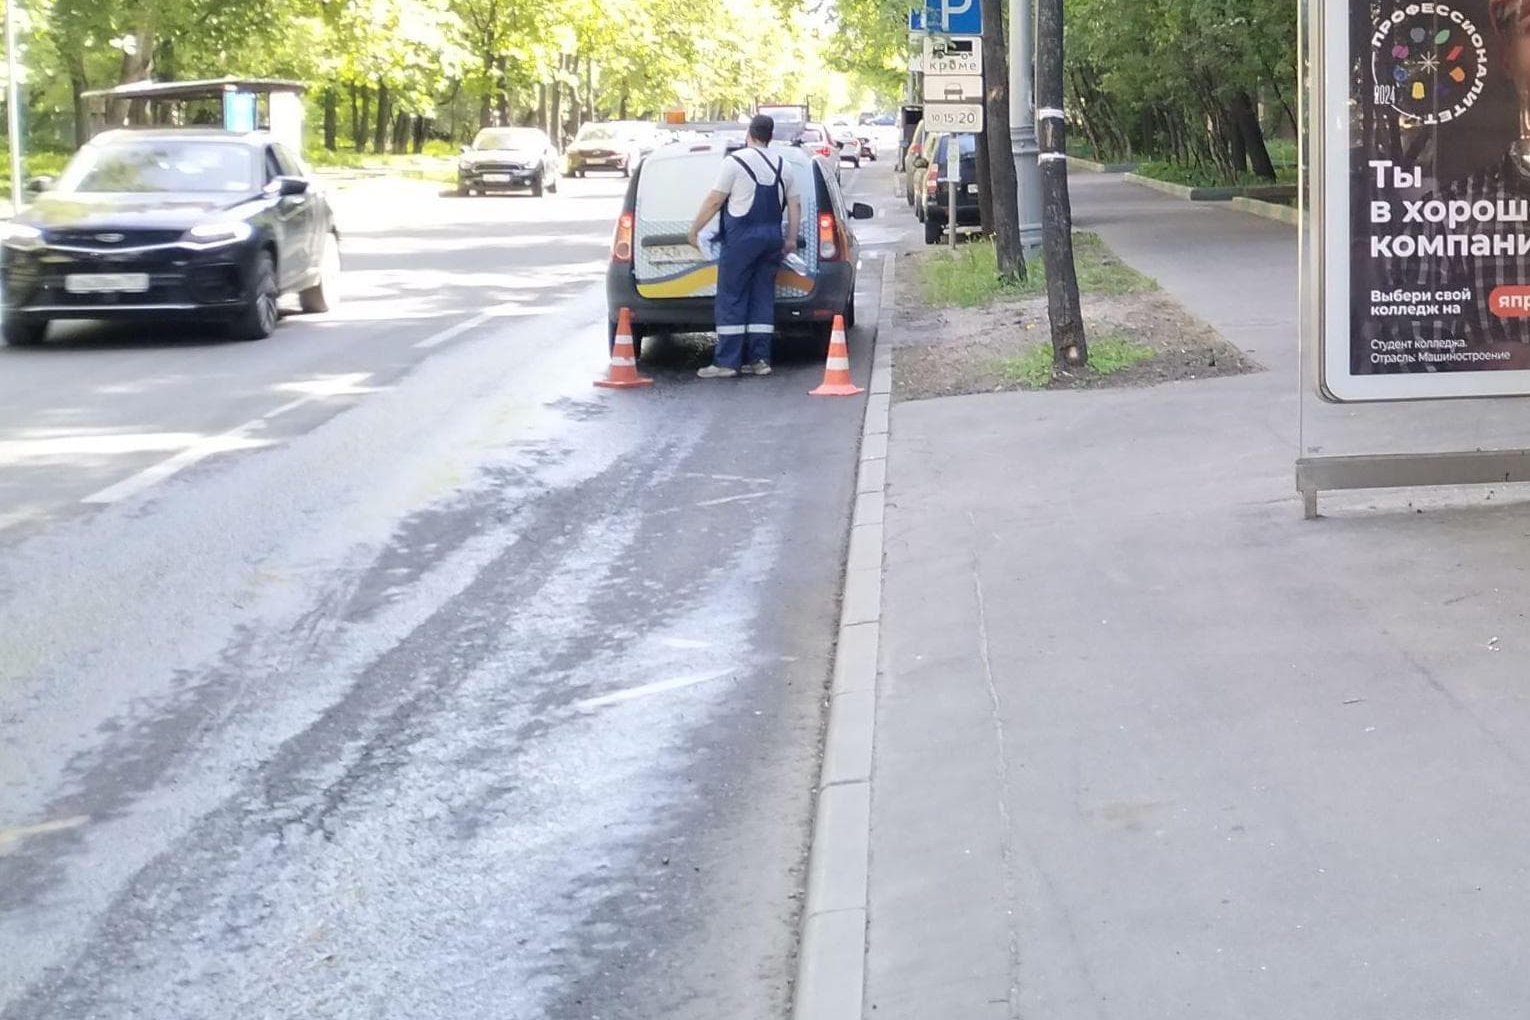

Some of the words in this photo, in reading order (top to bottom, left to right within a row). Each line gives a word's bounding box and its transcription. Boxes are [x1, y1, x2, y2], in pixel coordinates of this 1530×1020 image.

[1371, 3, 1487, 124] ПРОФЕССИОНАЛИТЕТ
[1374, 84, 1396, 104] 2024
[1368, 160, 1422, 188] Ты
[1370, 201, 1392, 223] в
[1370, 290, 1432, 303] Выбери
[1435, 288, 1471, 301] свой
[1370, 304, 1442, 316] колледж
[1443, 305, 1461, 314] на
[1370, 339, 1412, 351] Студент
[1414, 339, 1468, 350] колледжа.
[1370, 352, 1416, 364] Отрасль:
[1418, 351, 1511, 363] Машиностроение
